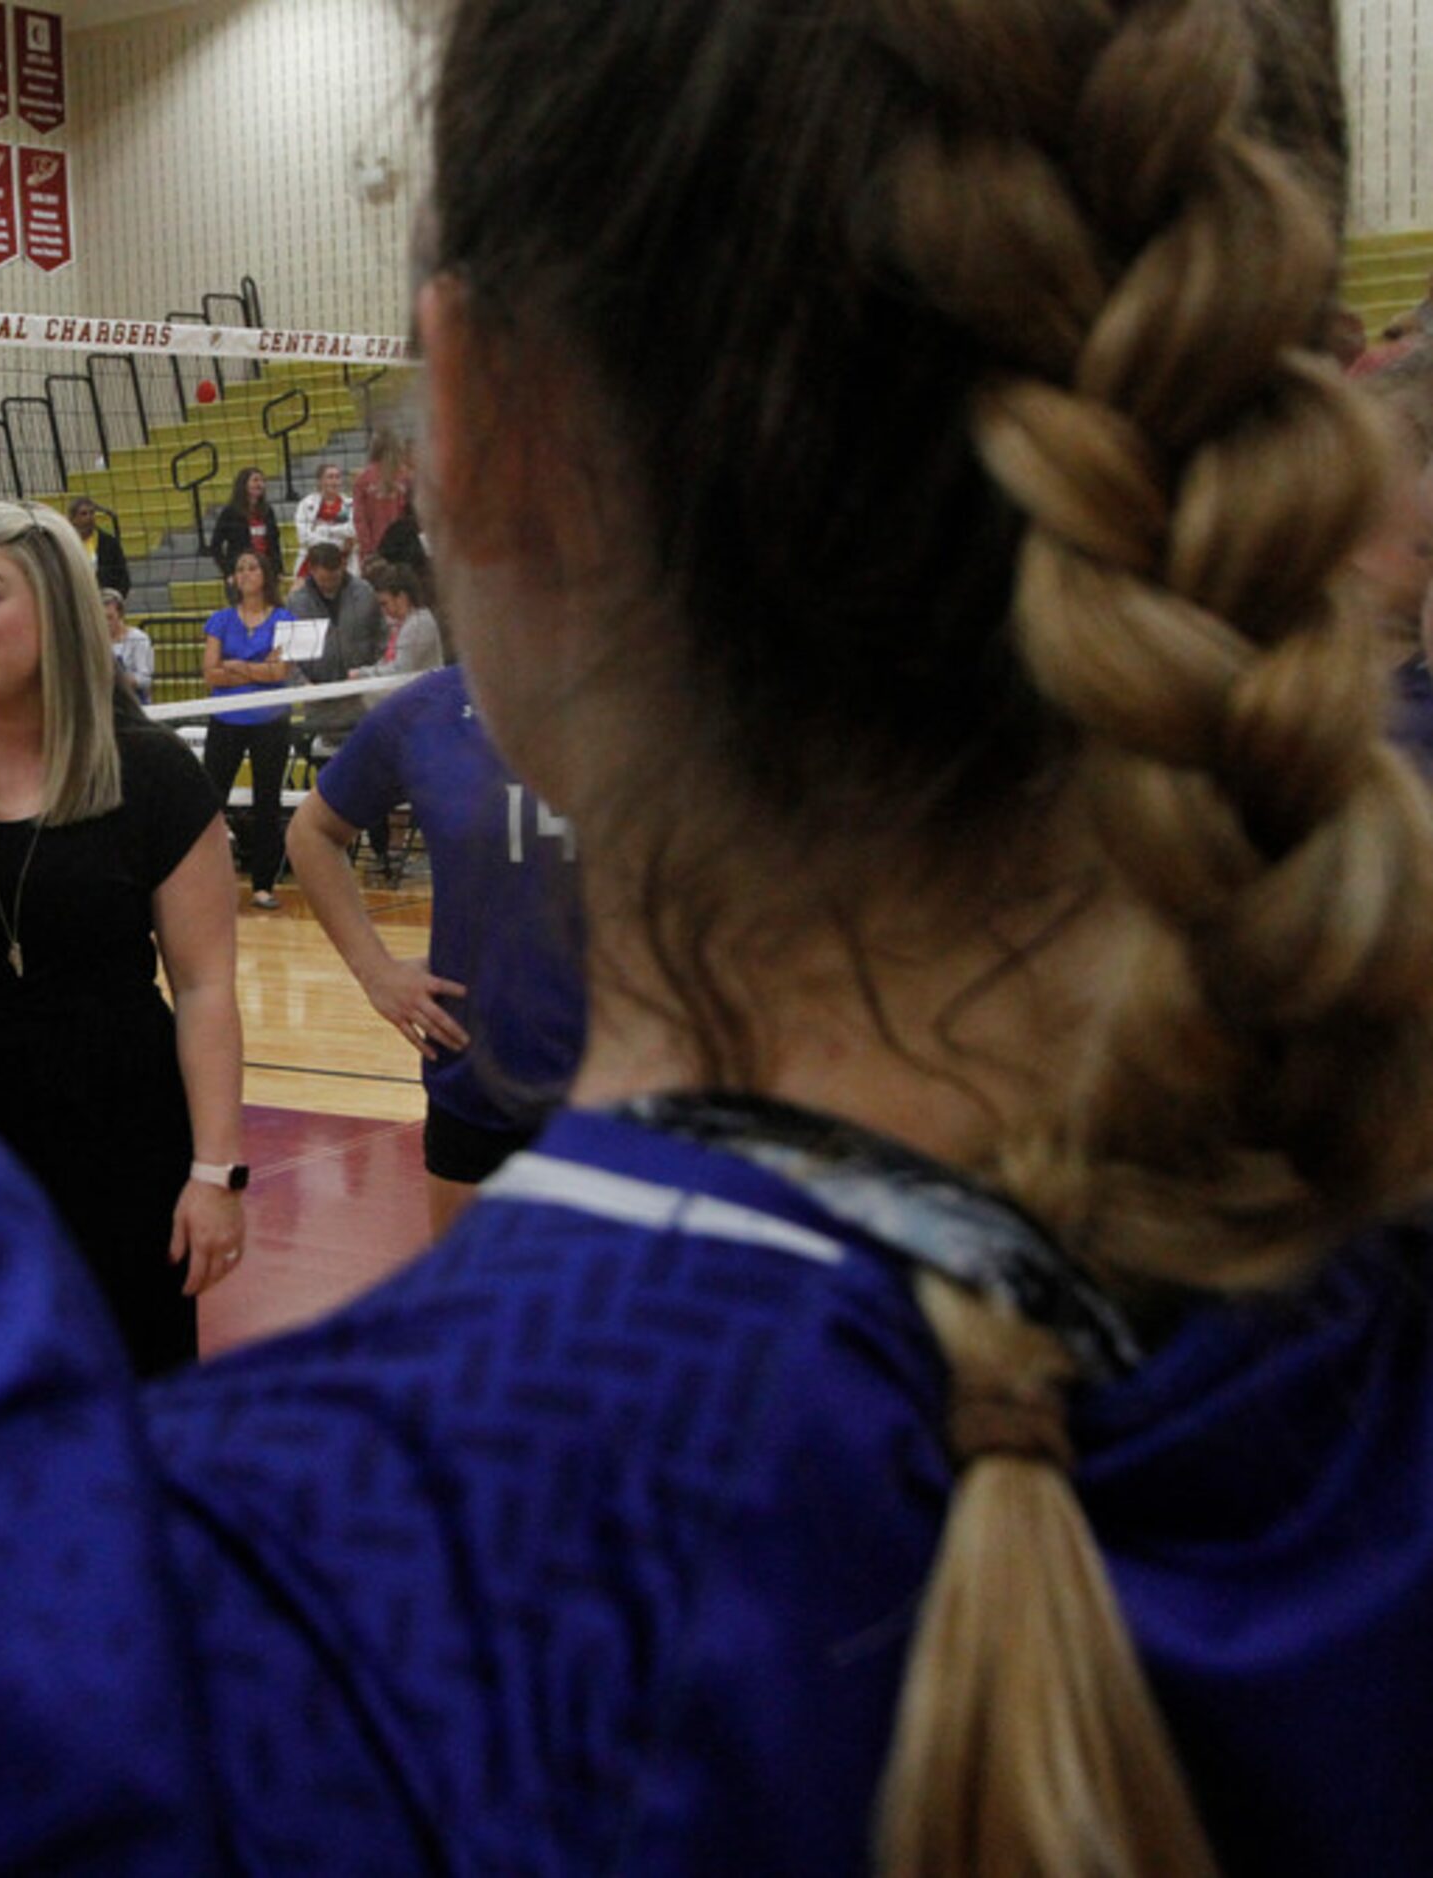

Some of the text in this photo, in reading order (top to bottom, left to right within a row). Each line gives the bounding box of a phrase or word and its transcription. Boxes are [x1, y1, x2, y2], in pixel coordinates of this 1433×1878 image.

[44, 318, 172, 346] CHARGERS
[259, 330, 353, 357] CENTRAL
[506, 783, 576, 862] 14
